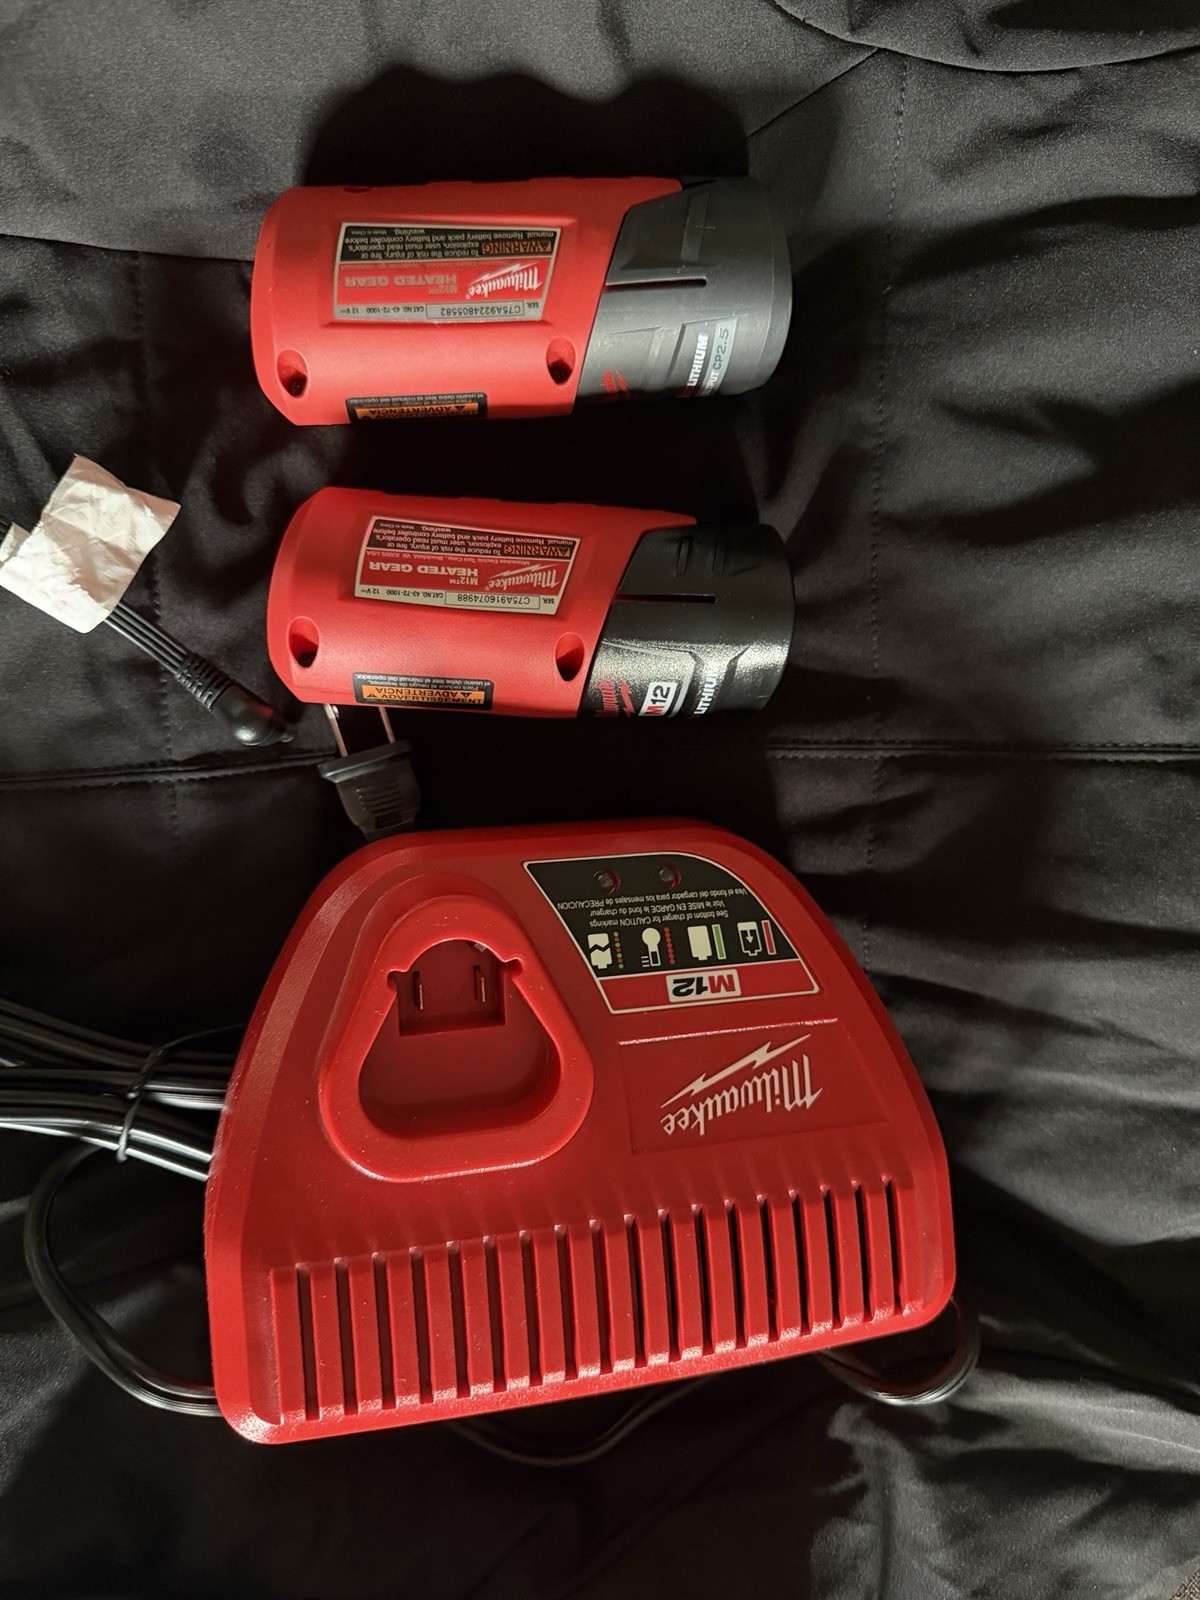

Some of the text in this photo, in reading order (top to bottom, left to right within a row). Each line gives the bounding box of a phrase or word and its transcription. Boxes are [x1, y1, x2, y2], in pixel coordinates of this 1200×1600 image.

[448, 234, 465, 242] pack
[467, 233, 491, 241] battery
[349, 244, 385, 252] operator's
[483, 241, 540, 253] WARNING
[444, 250, 469, 258] reduce
[344, 274, 456, 286] HEATED GEAR
[468, 267, 543, 298] Milwaukee
[440, 306, 521, 316] C75A9224805582
[712, 328, 729, 370] CP2.5
[686, 332, 709, 386] LITHIUM
[369, 405, 451, 415] ADVERTENCIA
[373, 528, 396, 536] before
[376, 535, 411, 543] operator's
[505, 545, 559, 556] WARNING
[368, 562, 478, 577] HEATED GEAR
[488, 569, 560, 590] Milwaukee
[387, 589, 420, 597] 43-72-1000
[457, 594, 530, 604] C75A916074988
[375, 688, 458, 698] ADVERTENCIA
[694, 667, 718, 715] LITHIU
[647, 685, 671, 716] M12
[615, 896, 644, 904] mensajes
[656, 893, 670, 901] para
[671, 891, 698, 900] cargador
[558, 900, 604, 910] PRECAUCION
[651, 904, 675, 913] GARDE
[688, 901, 705, 909] MISE
[628, 907, 643, 915] fond
[643, 906, 649, 914] le
[716, 910, 729, 918] See
[662, 913, 685, 922] charger
[694, 911, 715, 919] bottom
[590, 919, 618, 927] markings
[620, 916, 651, 926] CAUTION
[672, 973, 736, 997] M12
[660, 1054, 823, 1136] Milwaukee
